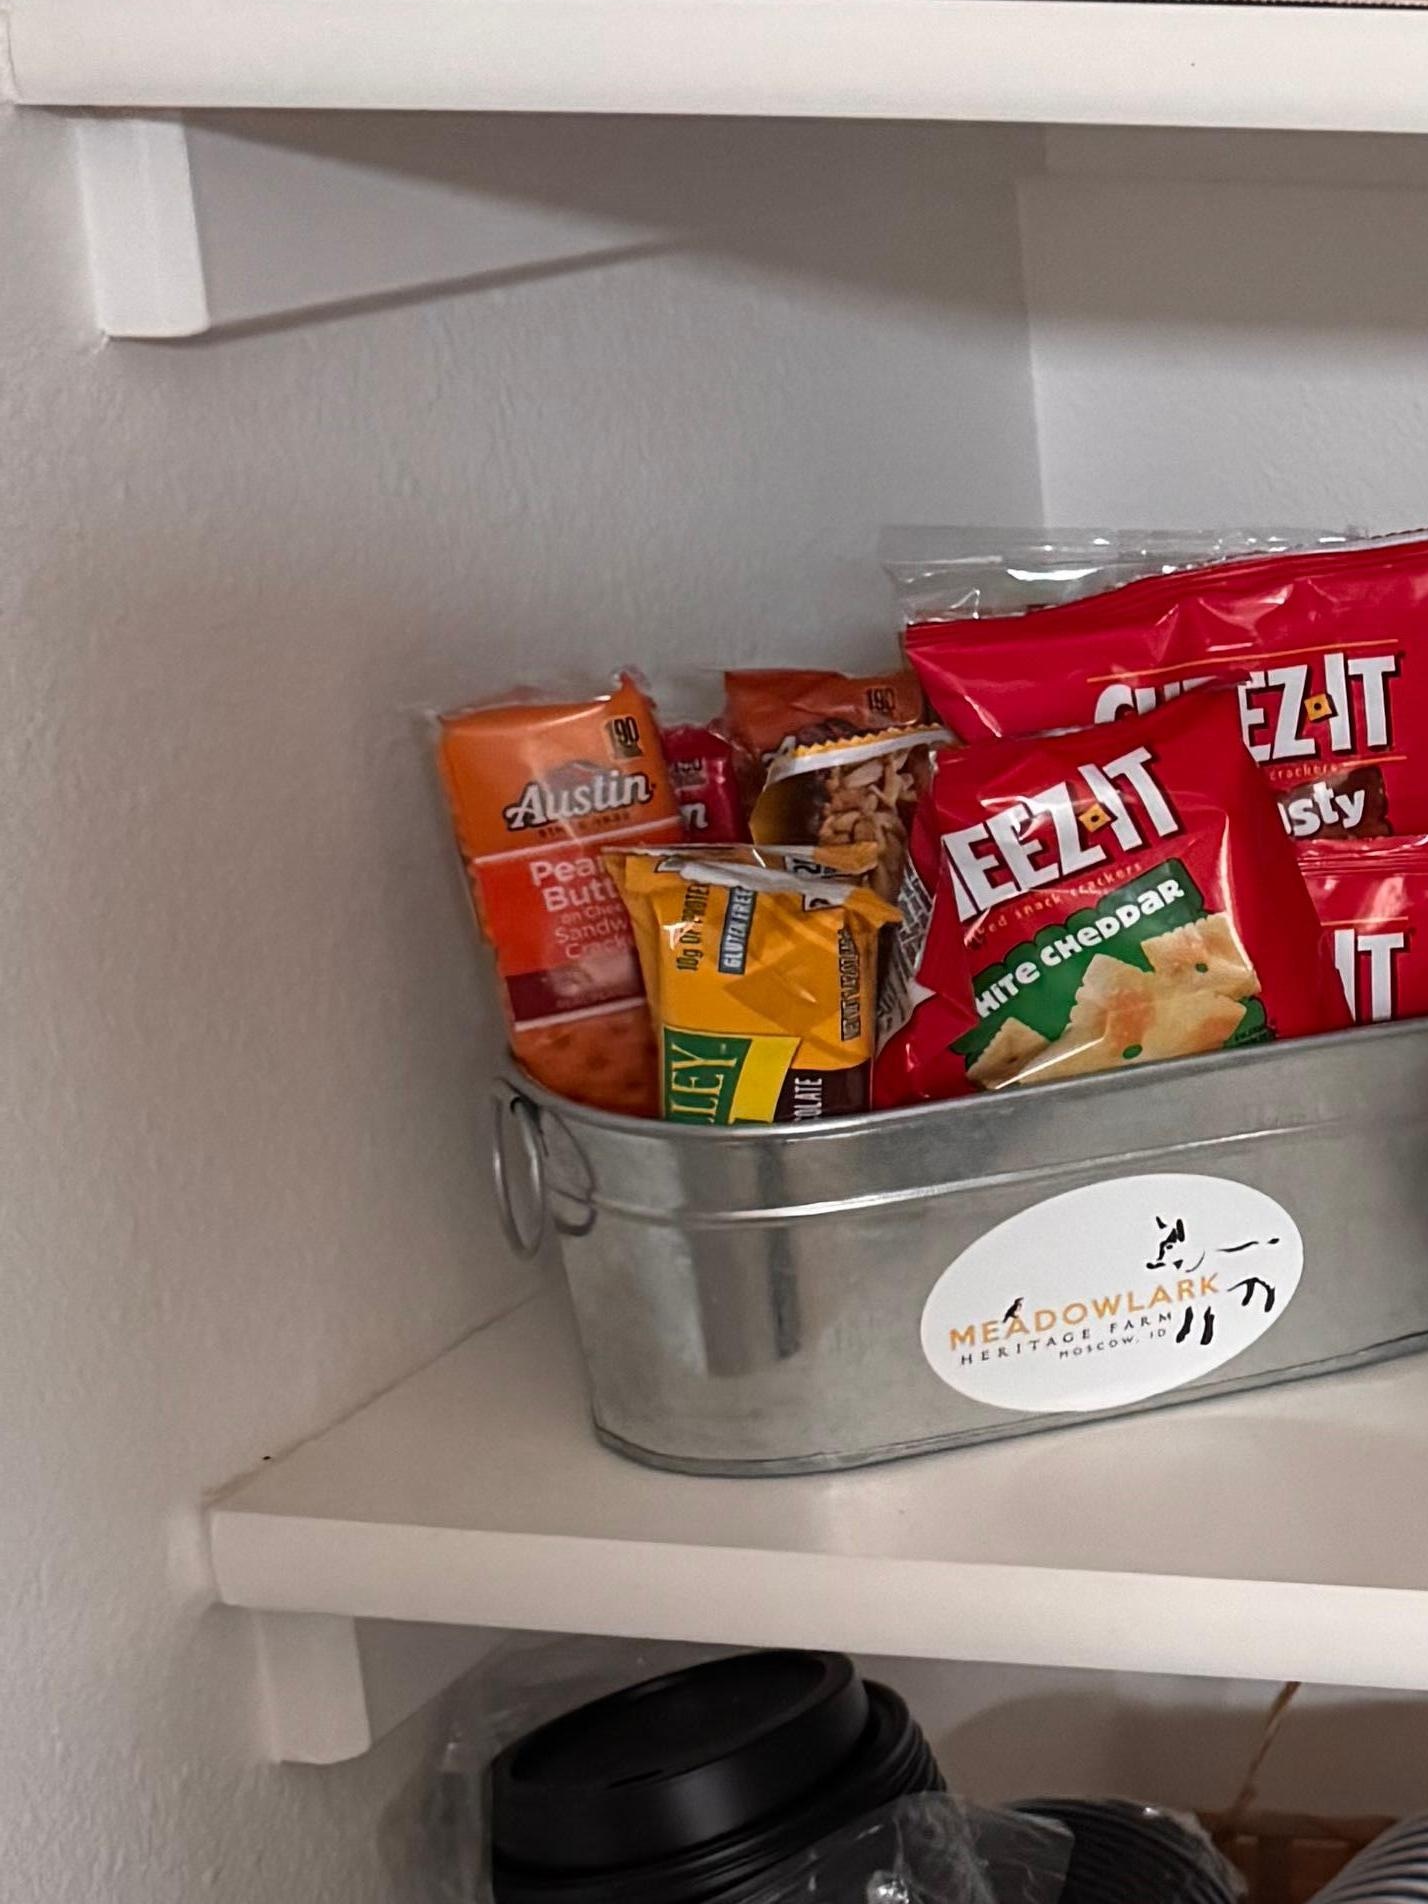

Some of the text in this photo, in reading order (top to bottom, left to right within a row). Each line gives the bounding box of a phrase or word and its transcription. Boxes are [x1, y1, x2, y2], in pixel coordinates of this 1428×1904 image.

[505, 770, 651, 829] Austin
[1277, 781, 1366, 836] sty
[543, 877, 618, 912] Butt
[975, 961, 1040, 1018] HITE
[949, 1273, 1220, 1351] MEADOWLARK
[961, 1311, 1173, 1366] HERITAGE FARM
[1059, 1328, 1167, 1359] MOSCOW, ID
